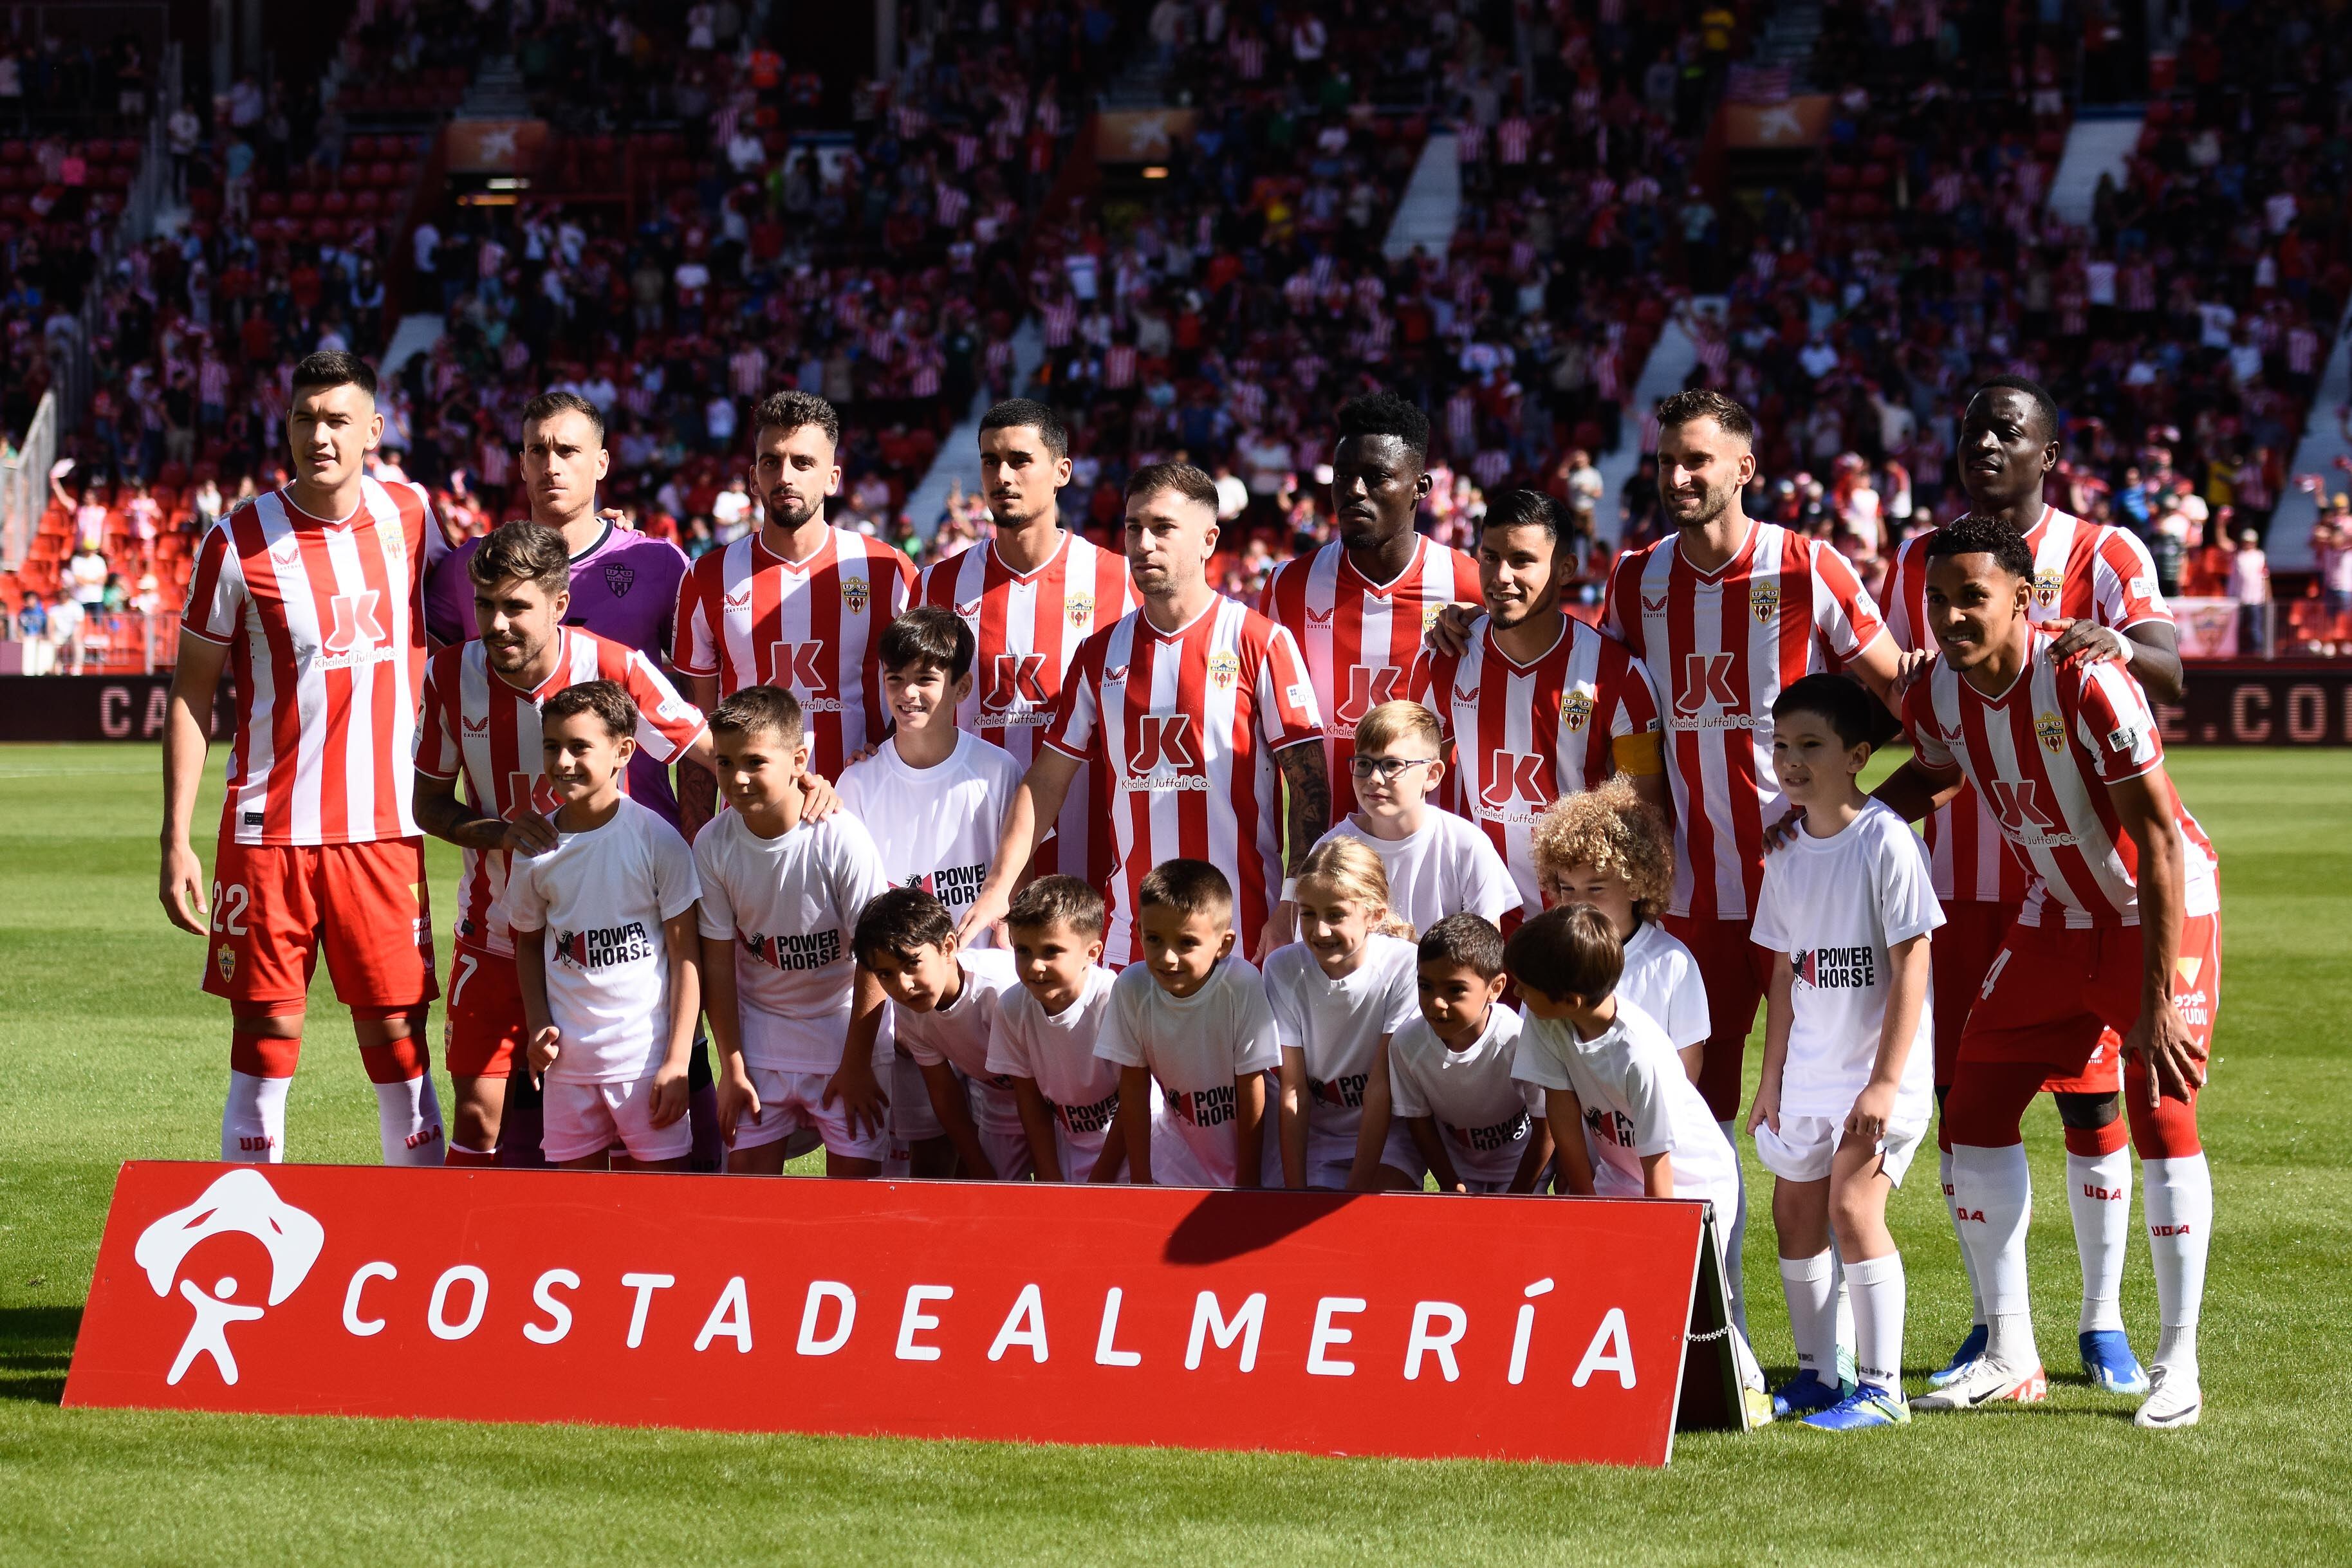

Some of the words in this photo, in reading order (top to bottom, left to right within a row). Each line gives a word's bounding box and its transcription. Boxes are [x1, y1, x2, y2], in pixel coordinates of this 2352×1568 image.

[313, 655, 351, 669] Khaled
[355, 651, 382, 664] Juffali
[383, 647, 398, 659] Co.
[983, 654, 1048, 710] JK
[1675, 652, 1739, 714] JK
[801, 699, 822, 710] ffali
[826, 698, 844, 710] Co.
[1453, 701, 1477, 710] CASTORE
[974, 714, 1005, 726] Khaled
[1008, 712, 1042, 724] Juffali
[1669, 717, 1698, 728] Khaled
[1703, 717, 1736, 728] Juffali
[1739, 716, 1758, 726] Co.
[1129, 714, 1193, 773] JK
[1122, 778, 1150, 790] Khaled
[1154, 777, 1188, 789] Juffali
[1192, 777, 1210, 789] Co.
[1481, 748, 1547, 806] JK
[1474, 806, 1504, 821] Khaled
[1508, 812, 1542, 825] Juffali
[2028, 836, 2057, 845] Juffali
[937, 883, 982, 907] HOR
[213, 881, 249, 936] 22
[588, 921, 647, 949] POWER
[777, 928, 840, 953] POWER
[589, 940, 652, 968] HORSE
[779, 945, 840, 971] HORSE
[1817, 946, 1873, 968] POWER
[1819, 967, 1875, 989] HORSE
[1982, 948, 2012, 1001] 4
[2180, 1009, 2208, 1026] UDU
[1194, 1086, 1234, 1109] POW
[1070, 1107, 1117, 1133] HOR
[1196, 1103, 1236, 1127] HOR
[239, 1136, 275, 1151] UDA
[405, 1124, 441, 1150] UDA
[2084, 1184, 2122, 1200] UDA
[1956, 1207, 1986, 1224] DA
[2151, 1224, 2190, 1237] UDA
